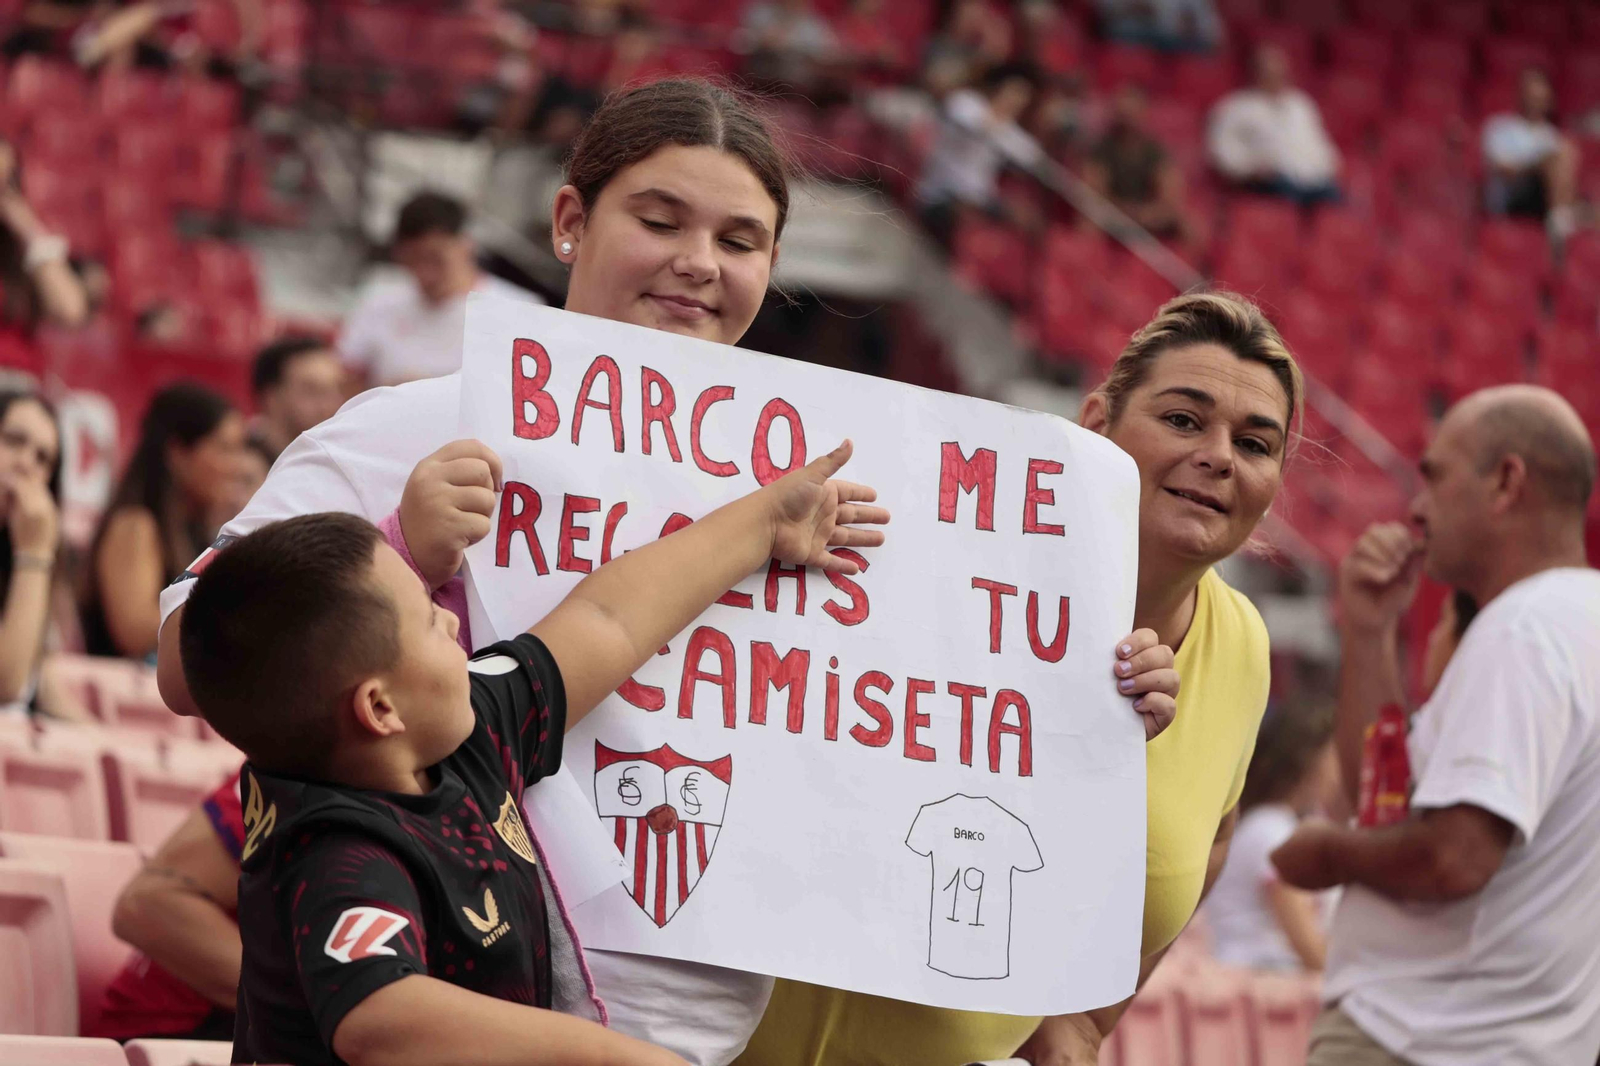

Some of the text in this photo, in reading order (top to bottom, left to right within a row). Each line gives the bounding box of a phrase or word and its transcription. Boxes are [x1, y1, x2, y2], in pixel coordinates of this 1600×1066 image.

[511, 337, 1065, 536] BARCO ME
[971, 576, 1070, 663] TU
[953, 827, 985, 842] BARCO
[943, 866, 985, 926] 19
[482, 921, 511, 948] CASTORE
